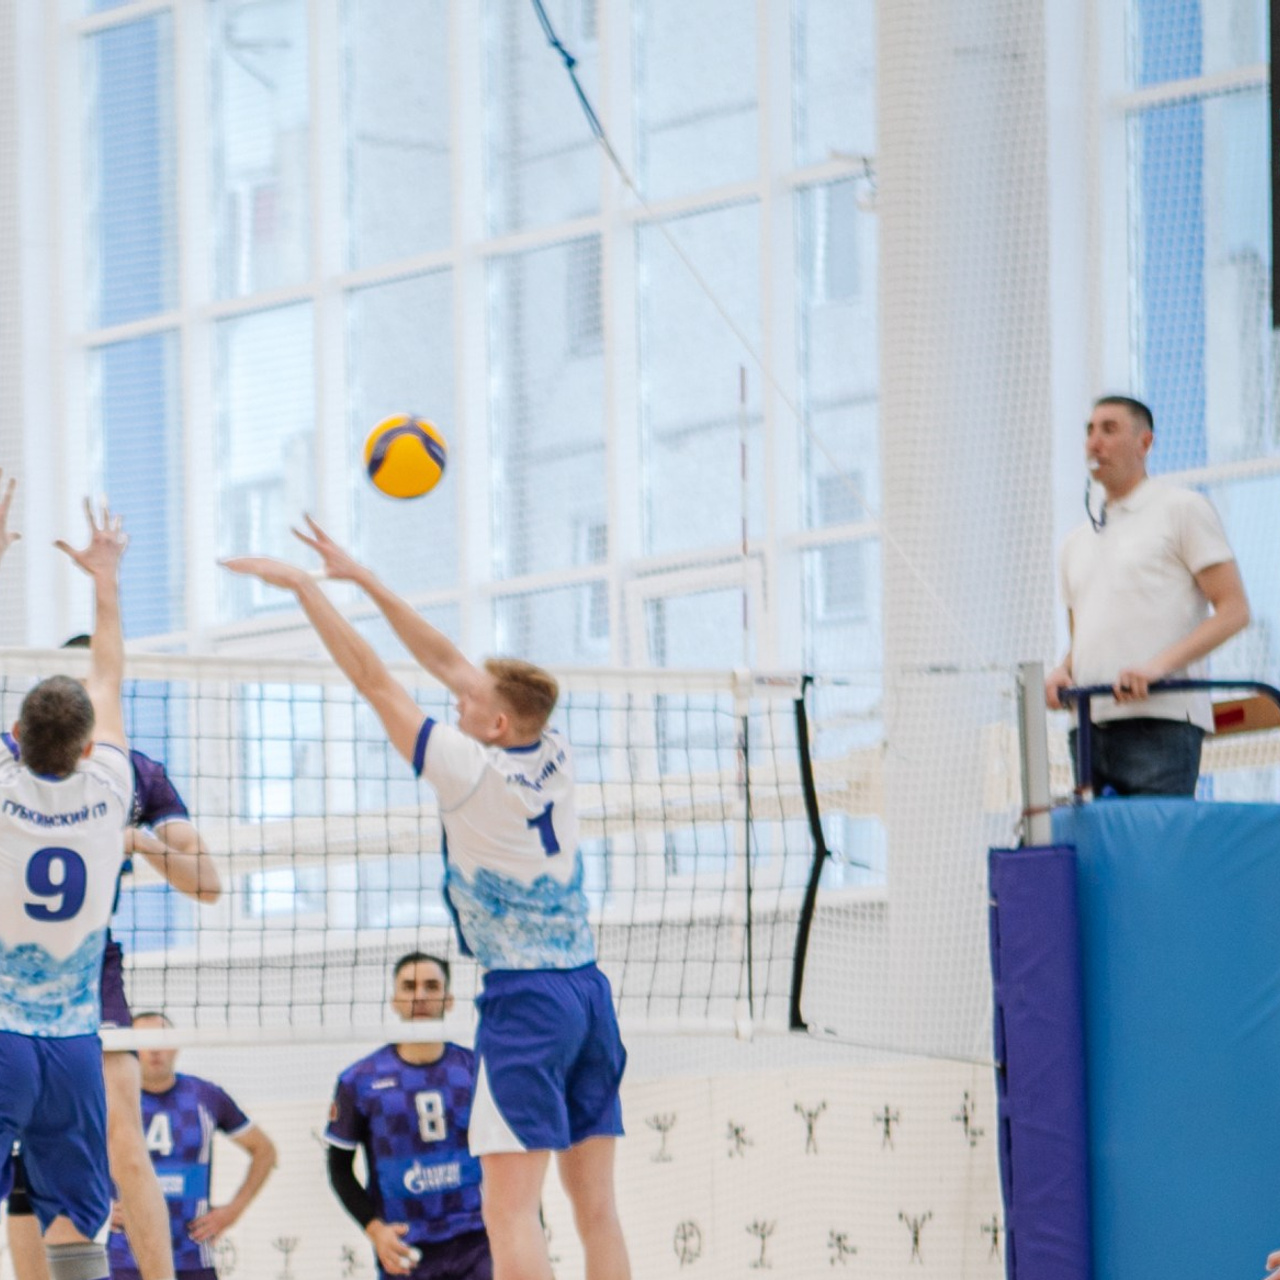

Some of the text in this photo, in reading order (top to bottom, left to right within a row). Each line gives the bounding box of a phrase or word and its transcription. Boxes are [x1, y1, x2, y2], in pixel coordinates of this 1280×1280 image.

[526, 800, 561, 858] 1
[24, 846, 88, 923] 9
[145, 1112, 173, 1156] 4
[414, 1090, 447, 1143] 8
